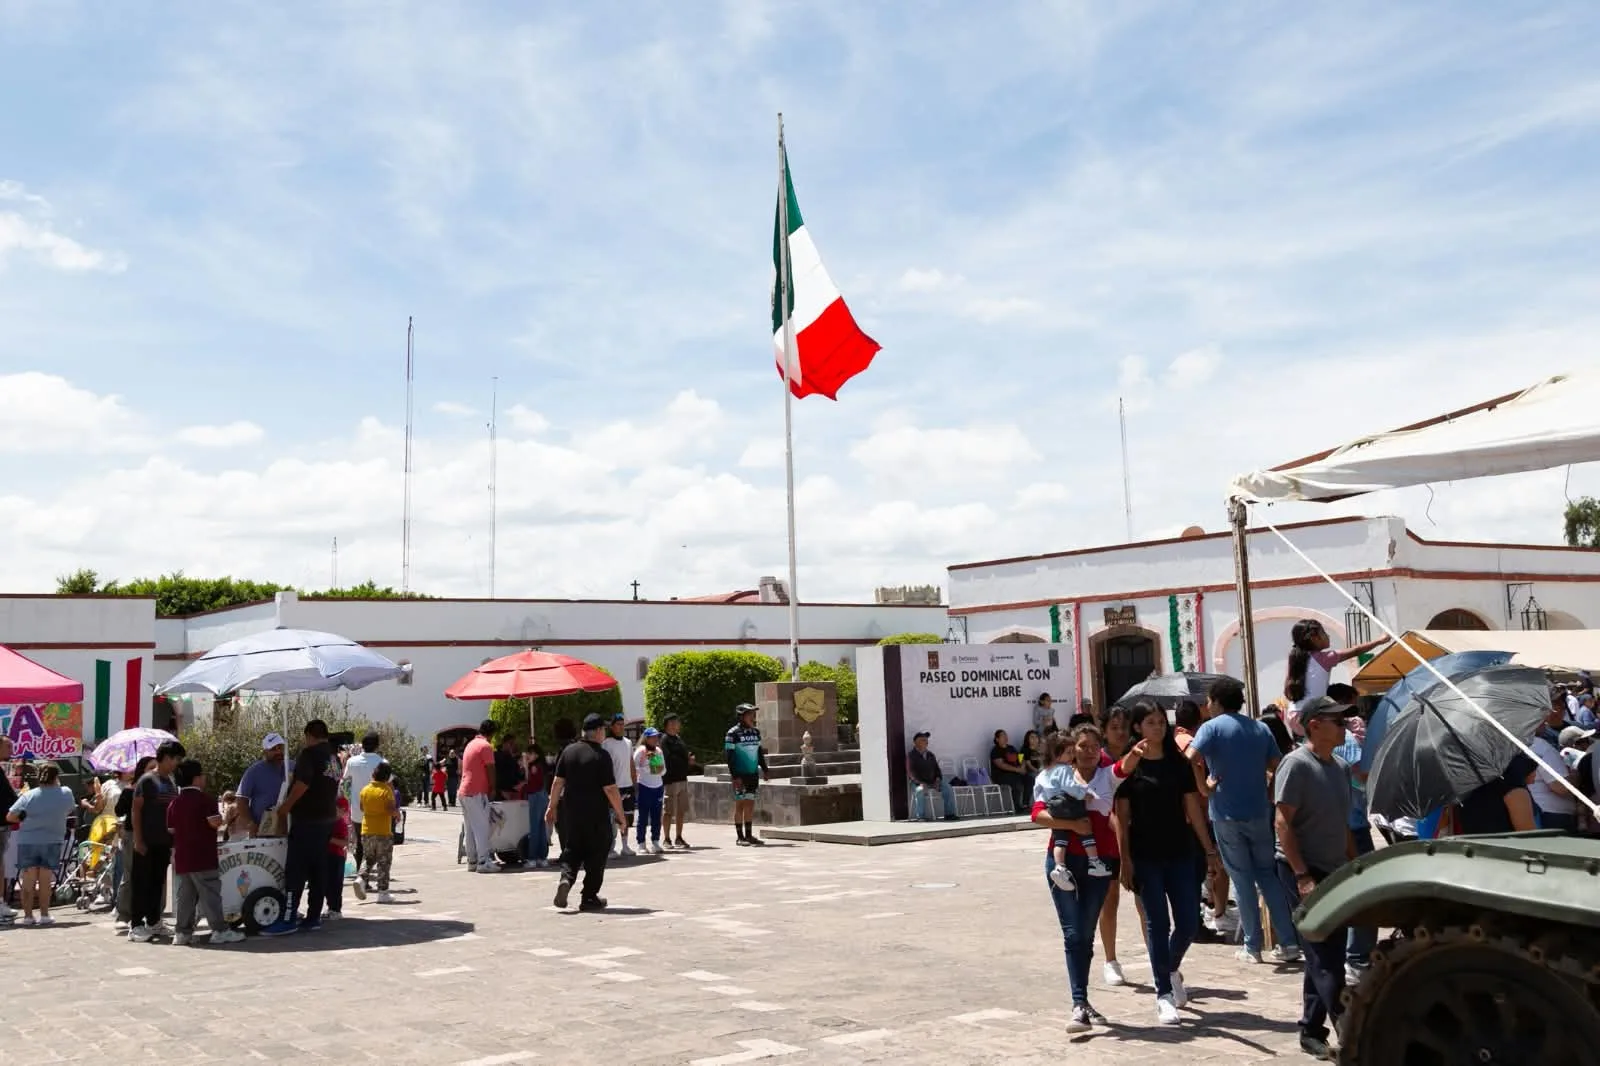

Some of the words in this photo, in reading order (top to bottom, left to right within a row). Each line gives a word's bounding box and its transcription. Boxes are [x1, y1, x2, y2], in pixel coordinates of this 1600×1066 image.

[920, 671, 956, 683] PASEO
[962, 669, 1023, 682] DOMINICAL
[1027, 669, 1050, 680] CON
[950, 686, 988, 698] LUCHA
[993, 685, 1021, 697] LIBRE
